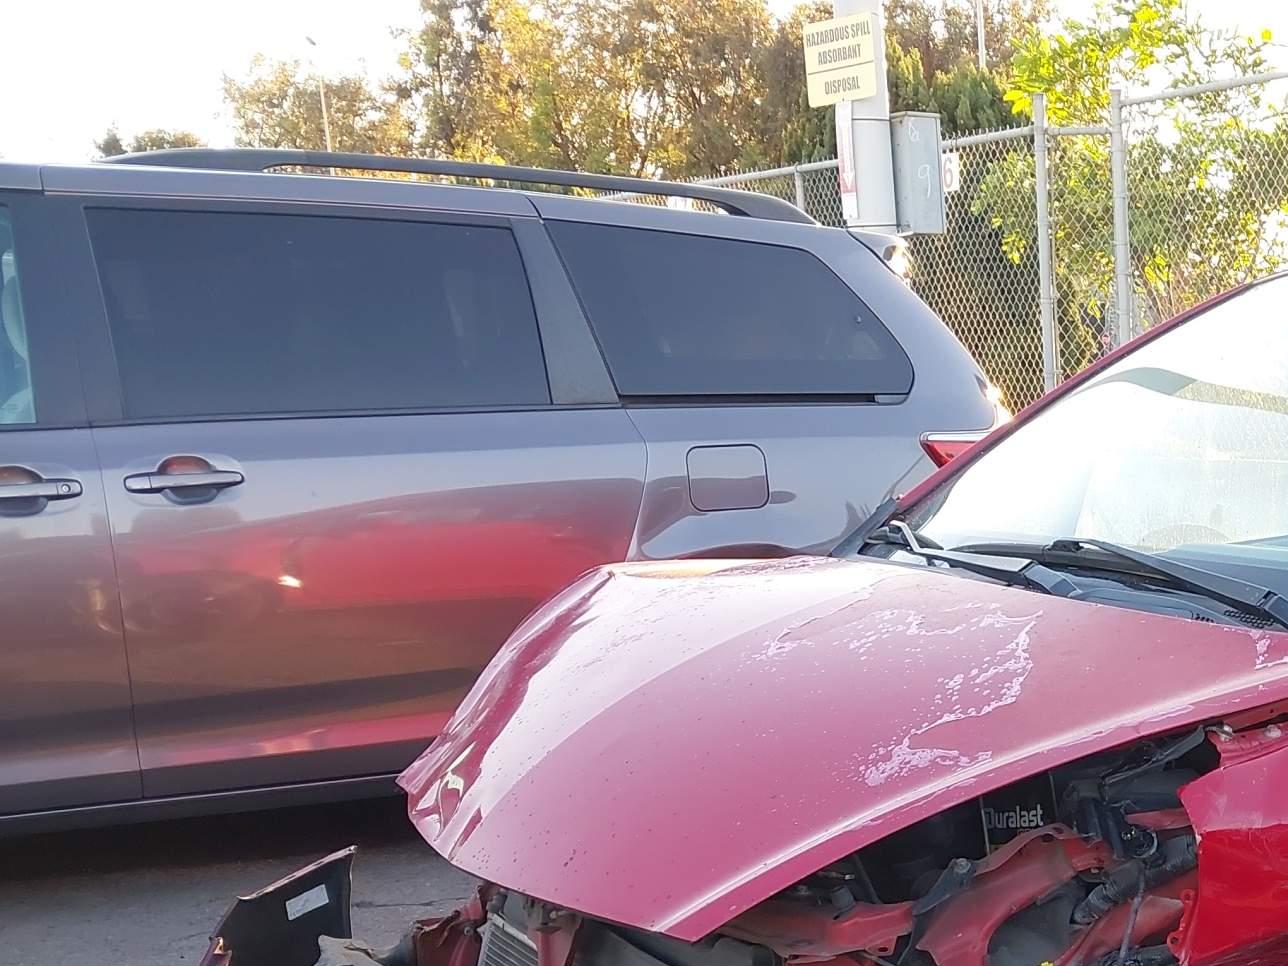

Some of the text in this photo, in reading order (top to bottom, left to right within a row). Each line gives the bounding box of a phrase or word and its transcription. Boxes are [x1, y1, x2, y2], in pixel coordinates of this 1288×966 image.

[805, 19, 871, 48] HAZARDOUS SPILL
[817, 43, 862, 66] ABSORBANT
[824, 75, 861, 95] DISPOSAL
[983, 803, 1044, 829] Duralast
